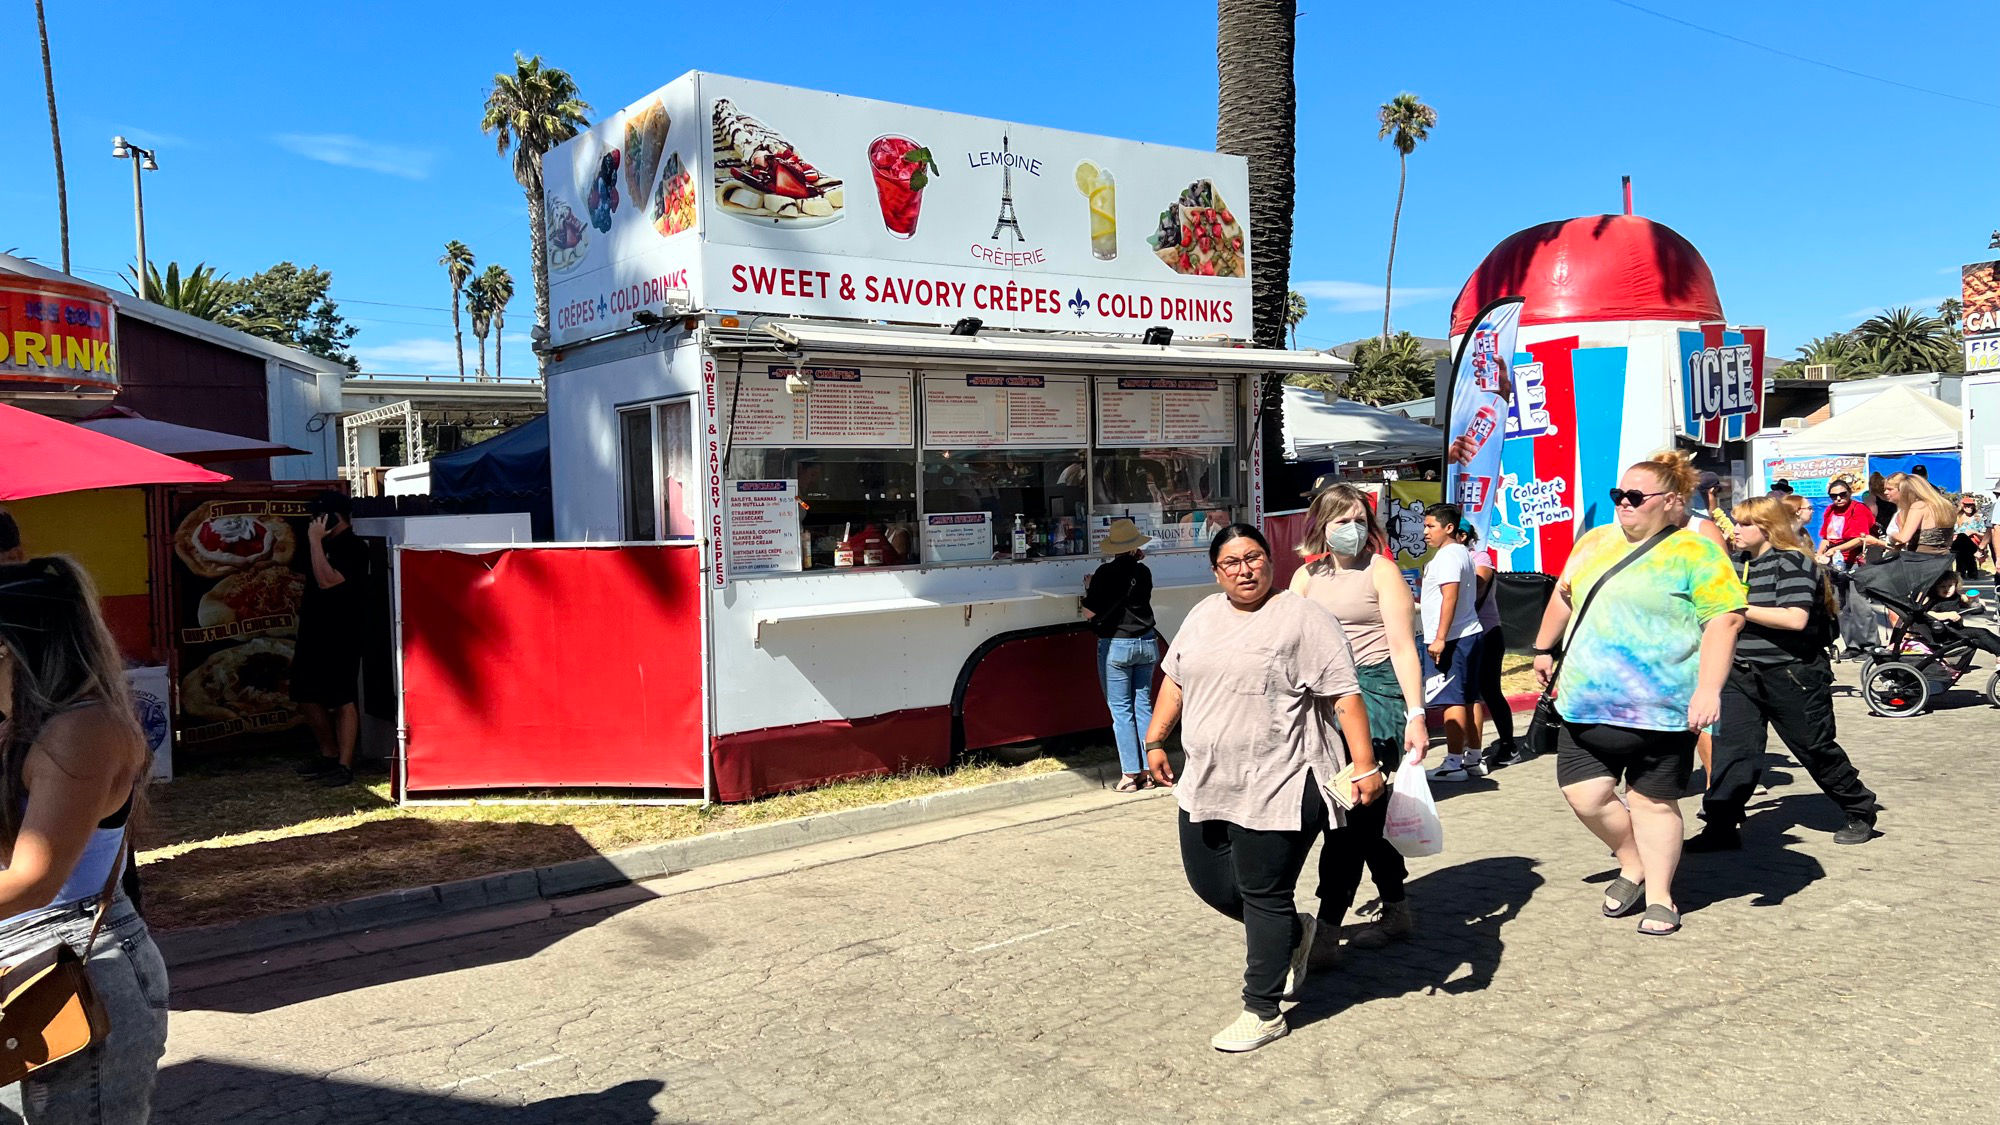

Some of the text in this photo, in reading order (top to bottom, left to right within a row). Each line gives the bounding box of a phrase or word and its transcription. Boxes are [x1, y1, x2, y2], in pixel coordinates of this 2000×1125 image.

[968, 151, 1042, 177] LEMOINE
[970, 244, 1046, 267] CRÊPERIE
[558, 268, 688, 330] CRÊPES COLD DRINKS
[731, 264, 1233, 323] SWEET & SAVORY CRÊPES COLD DRINKS
[1690, 346, 1754, 420] ICEE
[704, 361, 724, 585] SWEET & SAVORY CRÊPES
[1776, 462, 1817, 472] CARNE
[1820, 458, 1859, 468] ASADA
[1254, 481, 1261, 490] &
[1513, 480, 1563, 499] Coldest
[1522, 494, 1559, 513] Drink
[1520, 508, 1570, 526] in Town
